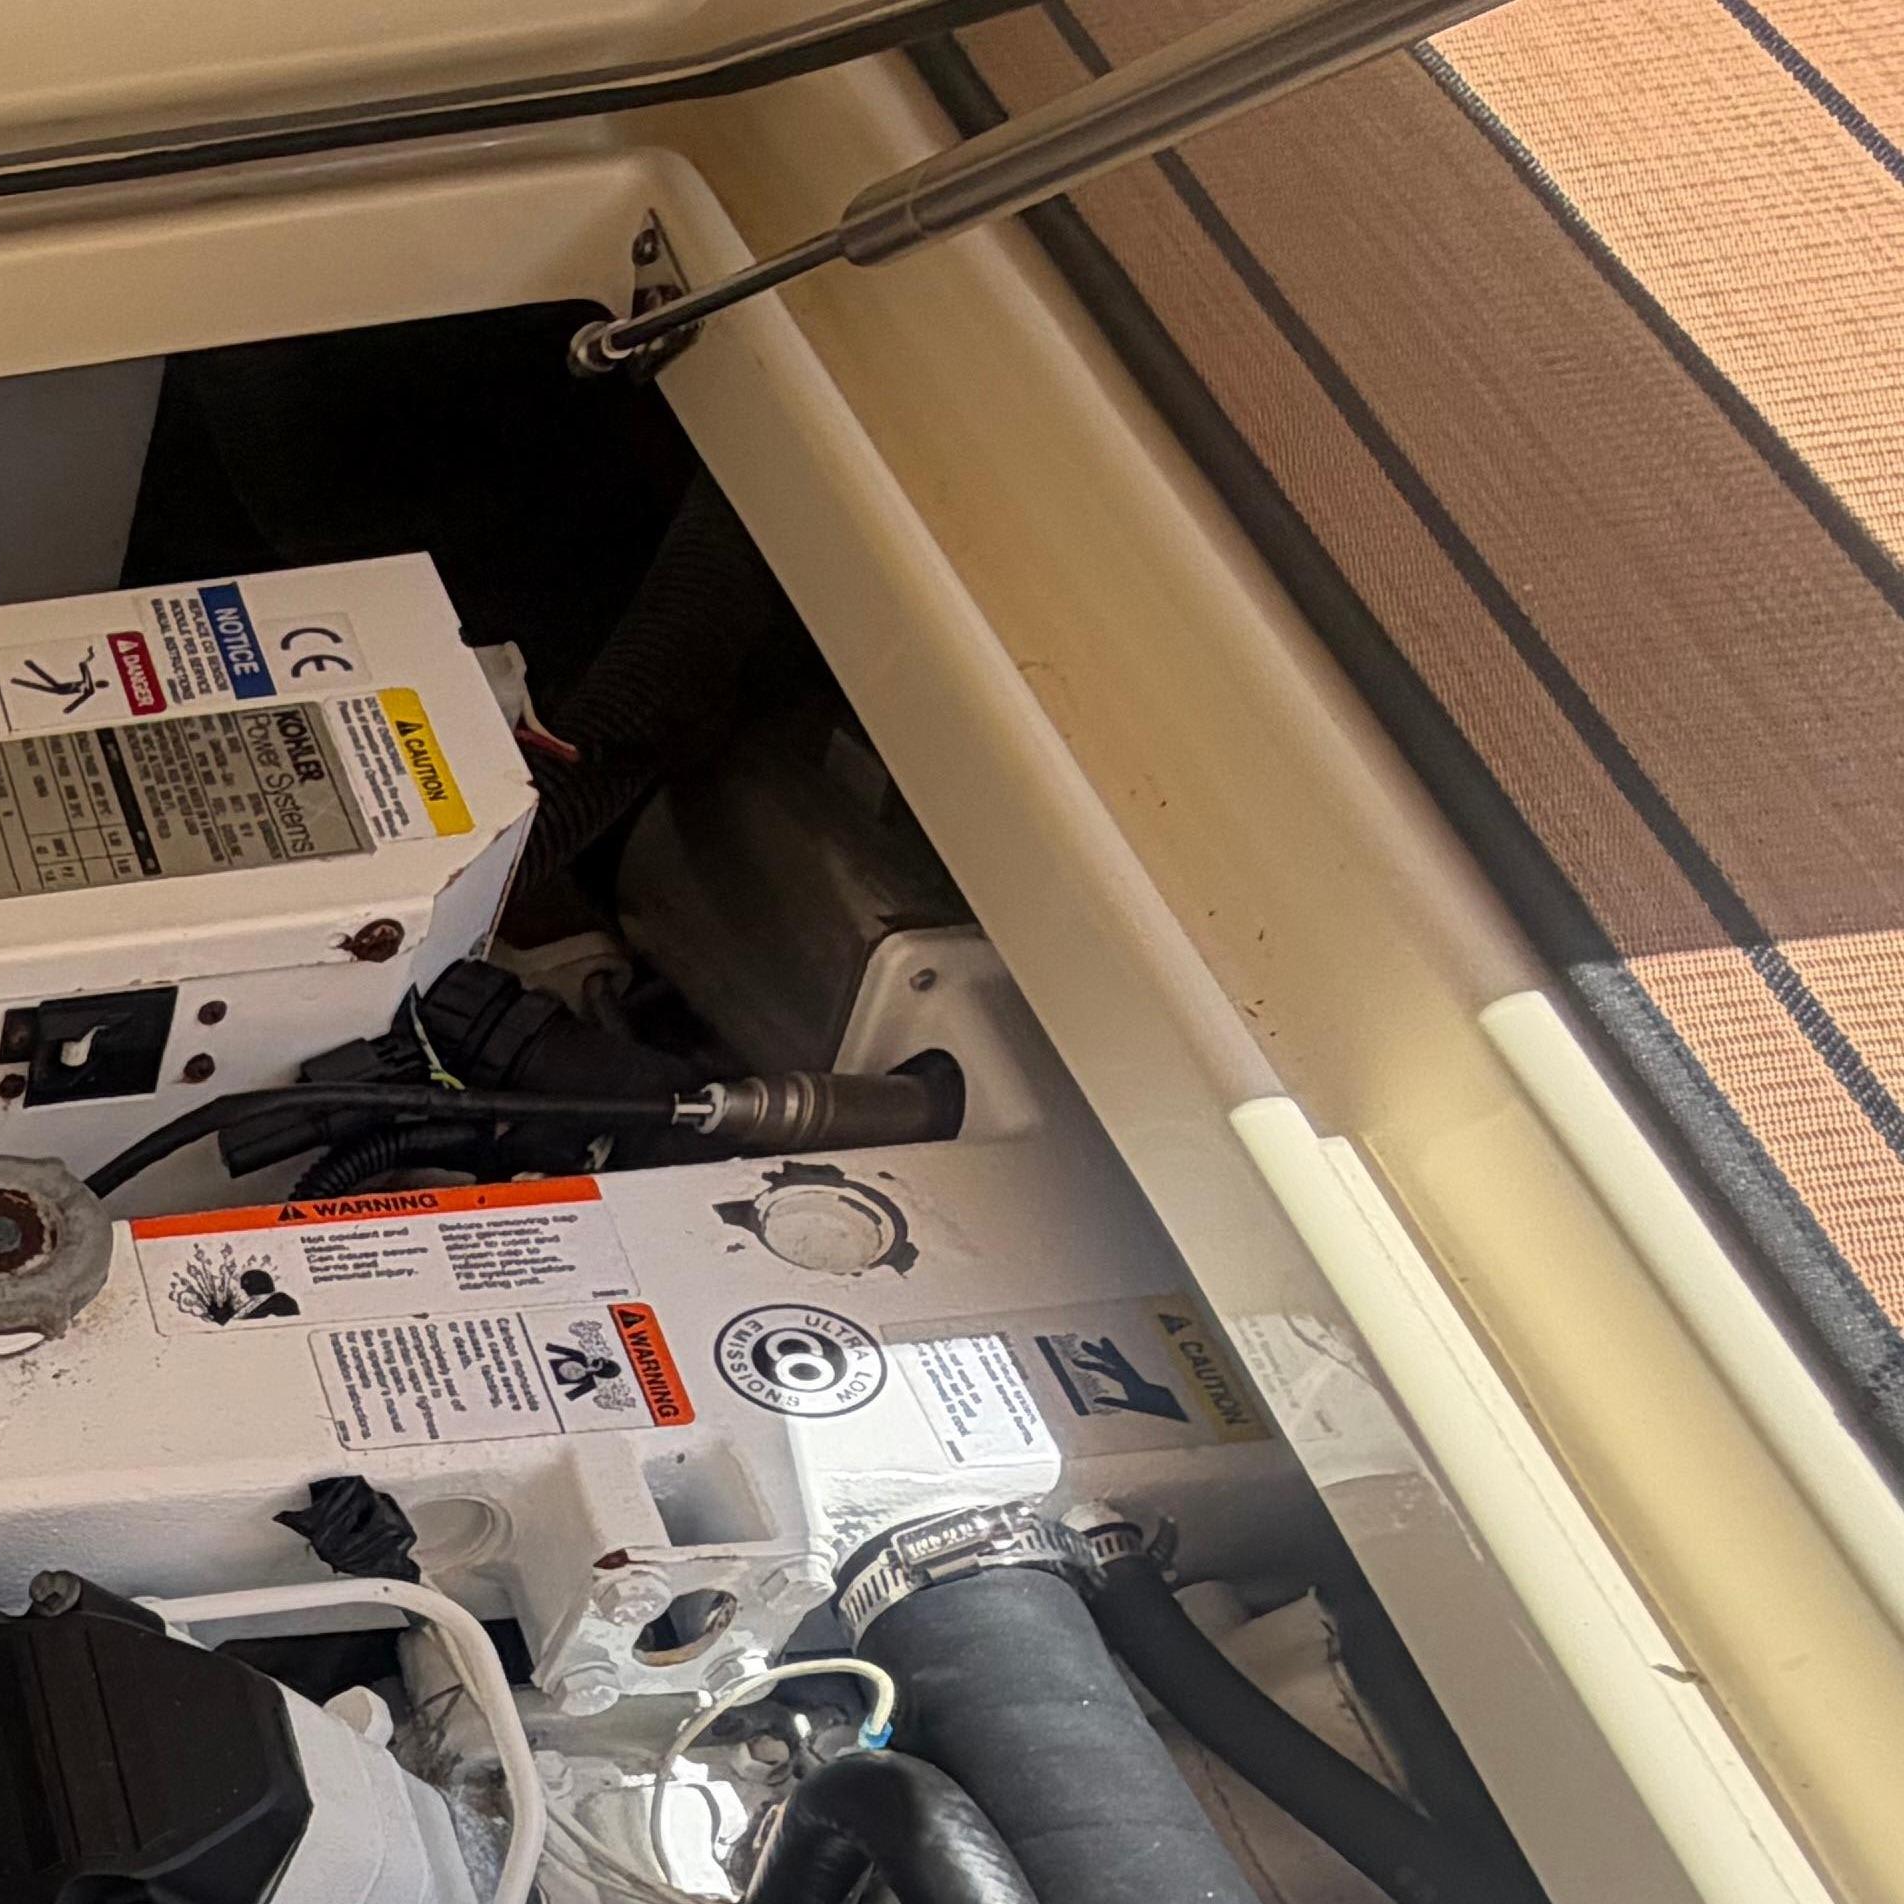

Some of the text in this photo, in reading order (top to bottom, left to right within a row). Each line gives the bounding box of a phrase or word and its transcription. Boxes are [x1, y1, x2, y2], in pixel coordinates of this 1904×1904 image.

[211, 606, 261, 676] NOTICE
[274, 623, 355, 681] CE
[121, 653, 155, 708] DANGER
[241, 711, 288, 773] Power
[272, 708, 326, 785] KOHLER
[402, 736, 449, 804] CAUTION
[259, 771, 318, 857] Systems
[312, 1192, 439, 1217] WARNING
[438, 1214, 579, 1232] Before removing cap
[300, 1234, 325, 1244] Hot
[381, 1226, 409, 1237] and
[306, 1247, 428, 1263] Can cause severe
[441, 1232, 473, 1242] stop
[448, 1250, 494, 1260] loosen
[496, 1248, 523, 1258] cap
[500, 1237, 530, 1246] cool
[533, 1234, 561, 1244] and
[308, 1260, 378, 1273] burns and
[311, 1270, 373, 1283] personal
[451, 1260, 497, 1270] relieve
[458, 1278, 512, 1292] starting
[478, 1268, 528, 1280] system
[530, 1263, 577, 1274] before
[359, 1329, 377, 1347] See
[382, 1398, 407, 1433] manual
[478, 1319, 523, 1411] can cause severe
[494, 1317, 542, 1412] Carbon monoxide
[625, 1330, 682, 1417] WARNING
[727, 1319, 800, 1407] EMISSIONS
[805, 1314, 873, 1403] ULTRA LOW
[977, 1355, 1000, 1381] cause
[993, 1384, 1018, 1414] severe
[1175, 1339, 1251, 1425] CAUTION
